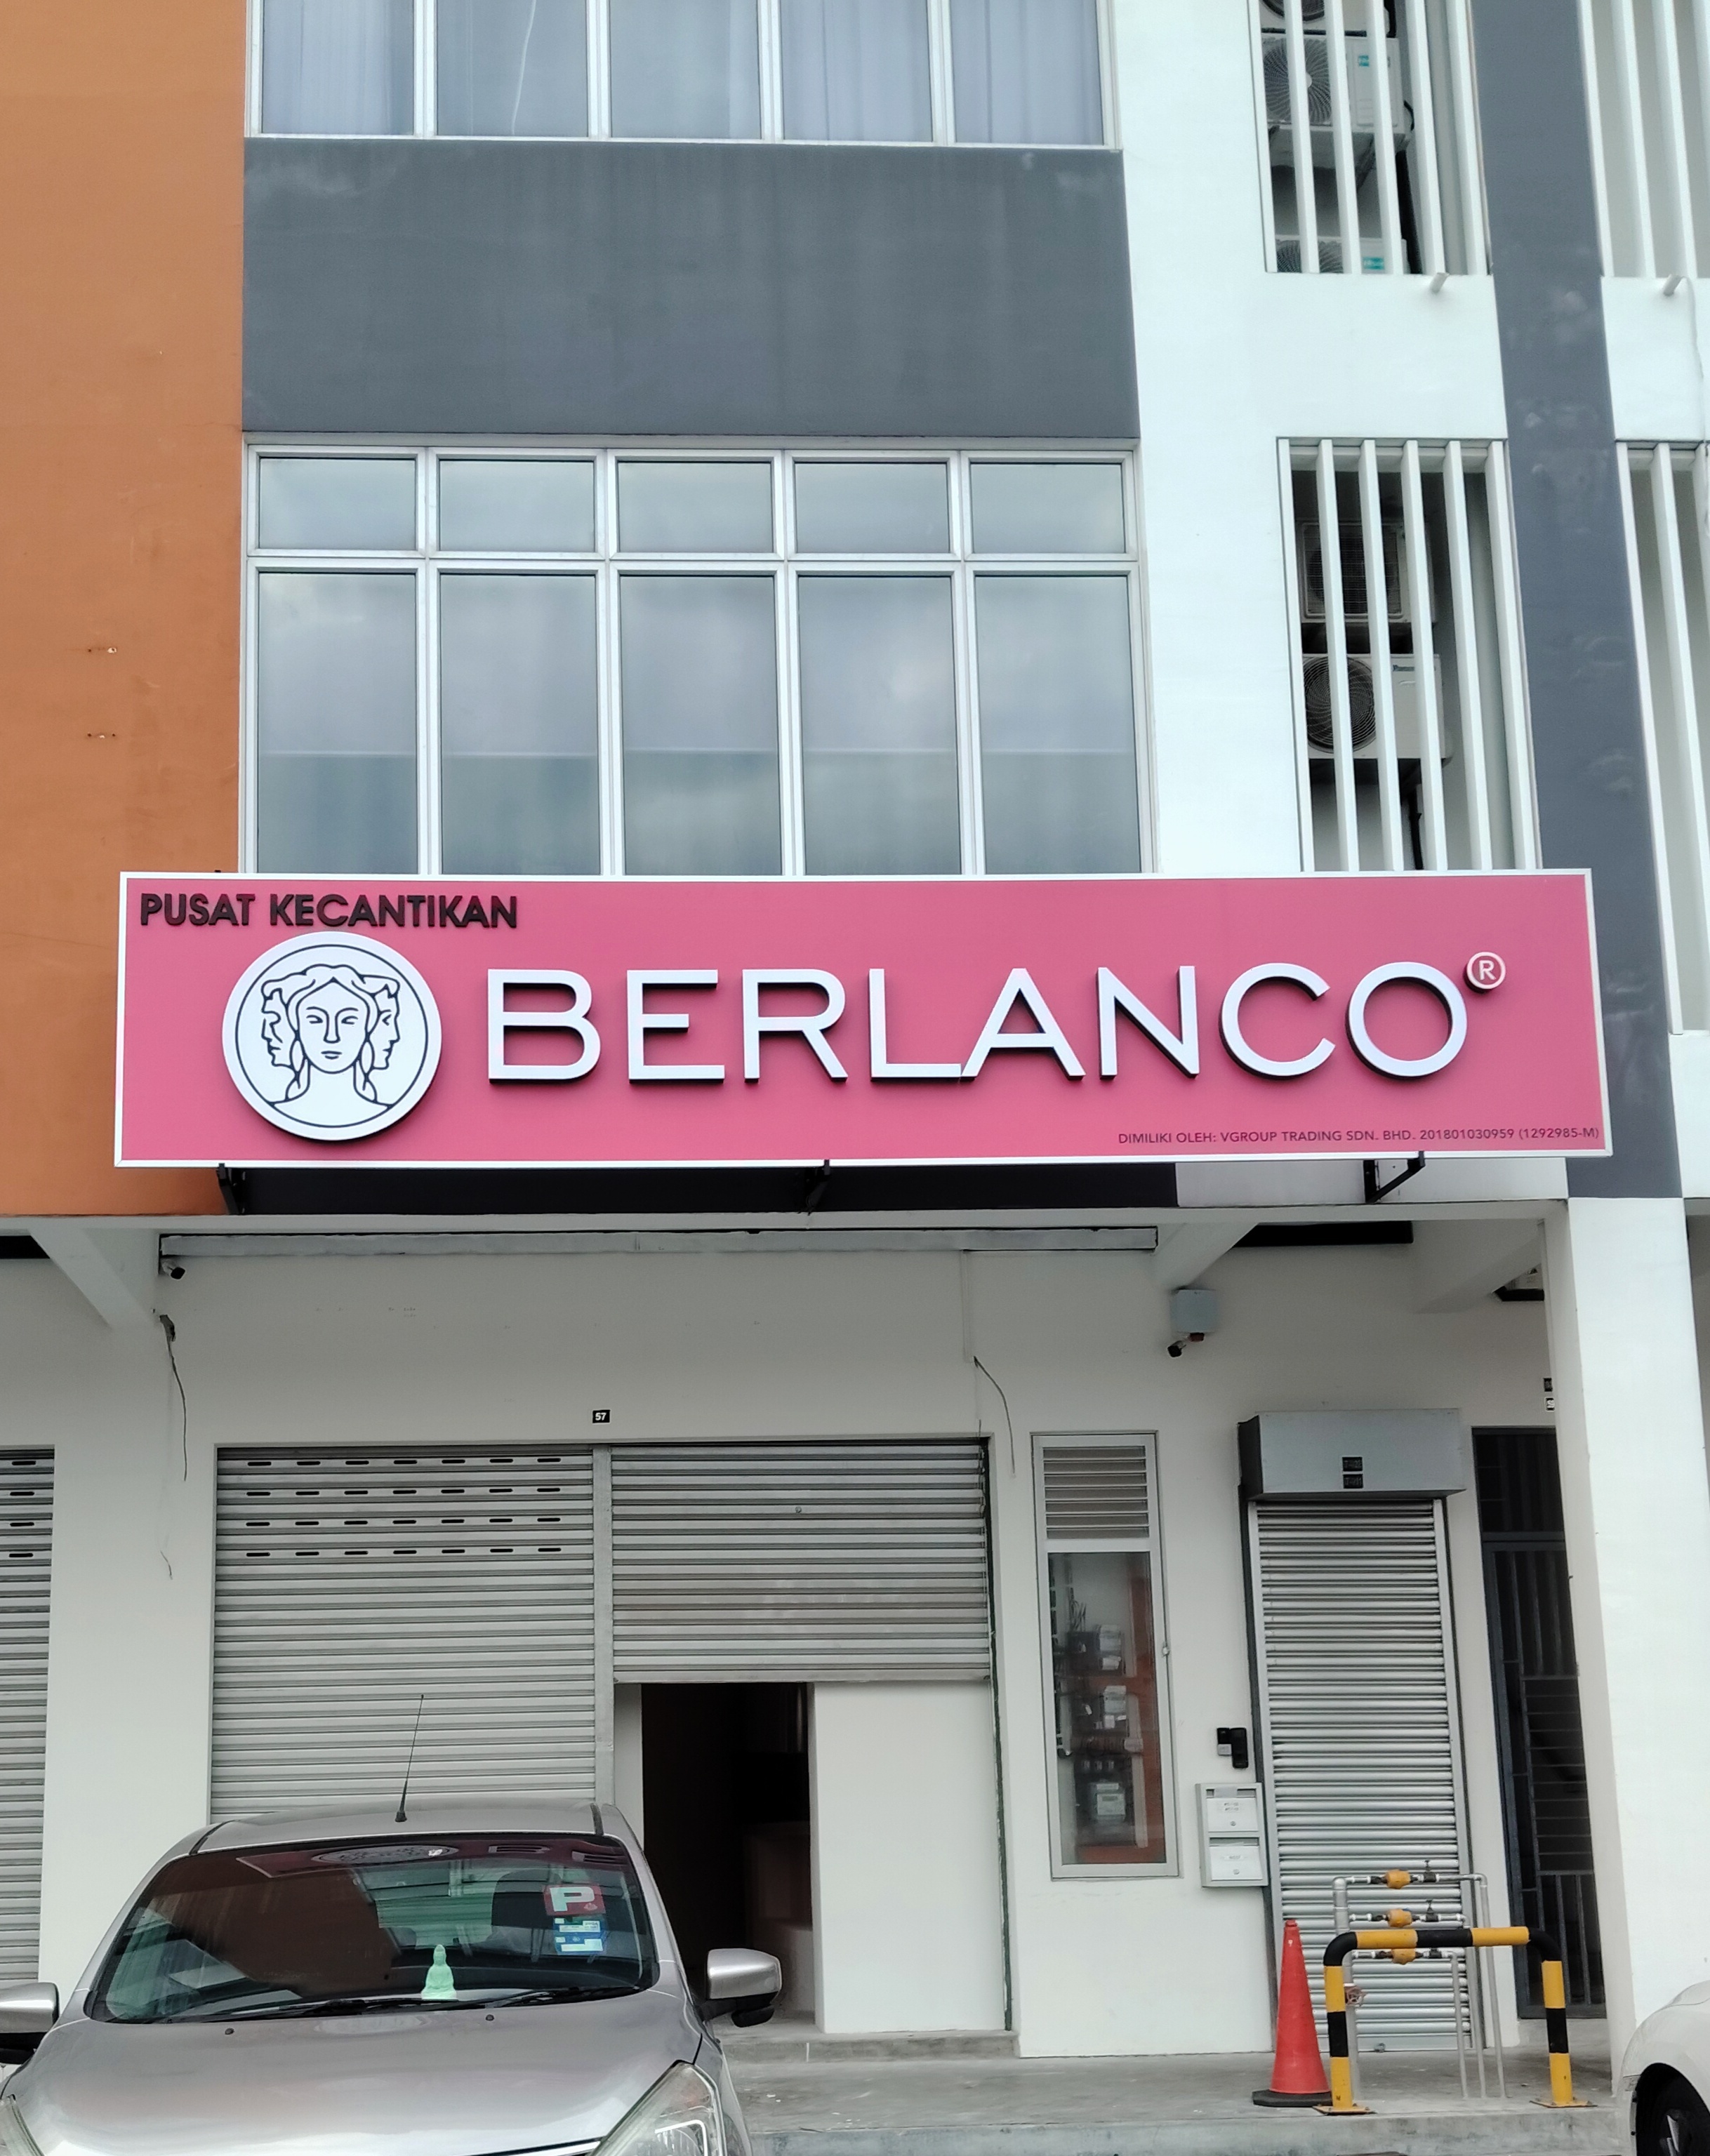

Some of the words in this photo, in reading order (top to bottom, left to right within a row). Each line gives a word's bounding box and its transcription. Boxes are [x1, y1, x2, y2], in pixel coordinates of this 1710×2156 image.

[140, 893, 256, 926] PUSAT
[270, 893, 517, 929] KECANTIKAN
[487, 961, 1468, 1082] BERLANCO
[1118, 1133, 1172, 1144] DIMILIKI
[1176, 1132, 1217, 1143] OLEH:
[1220, 1131, 1277, 1143] VGROUP
[1281, 1131, 1342, 1142] TRADING
[1346, 1130, 1379, 1141] SDN.
[1383, 1129, 1417, 1140] BHD.
[1419, 1129, 1514, 1140] 201801030959
[1518, 1127, 1599, 1140] (1292985-M)
[595, 1412, 607, 1421] 57
[549, 1886, 595, 1912] P
